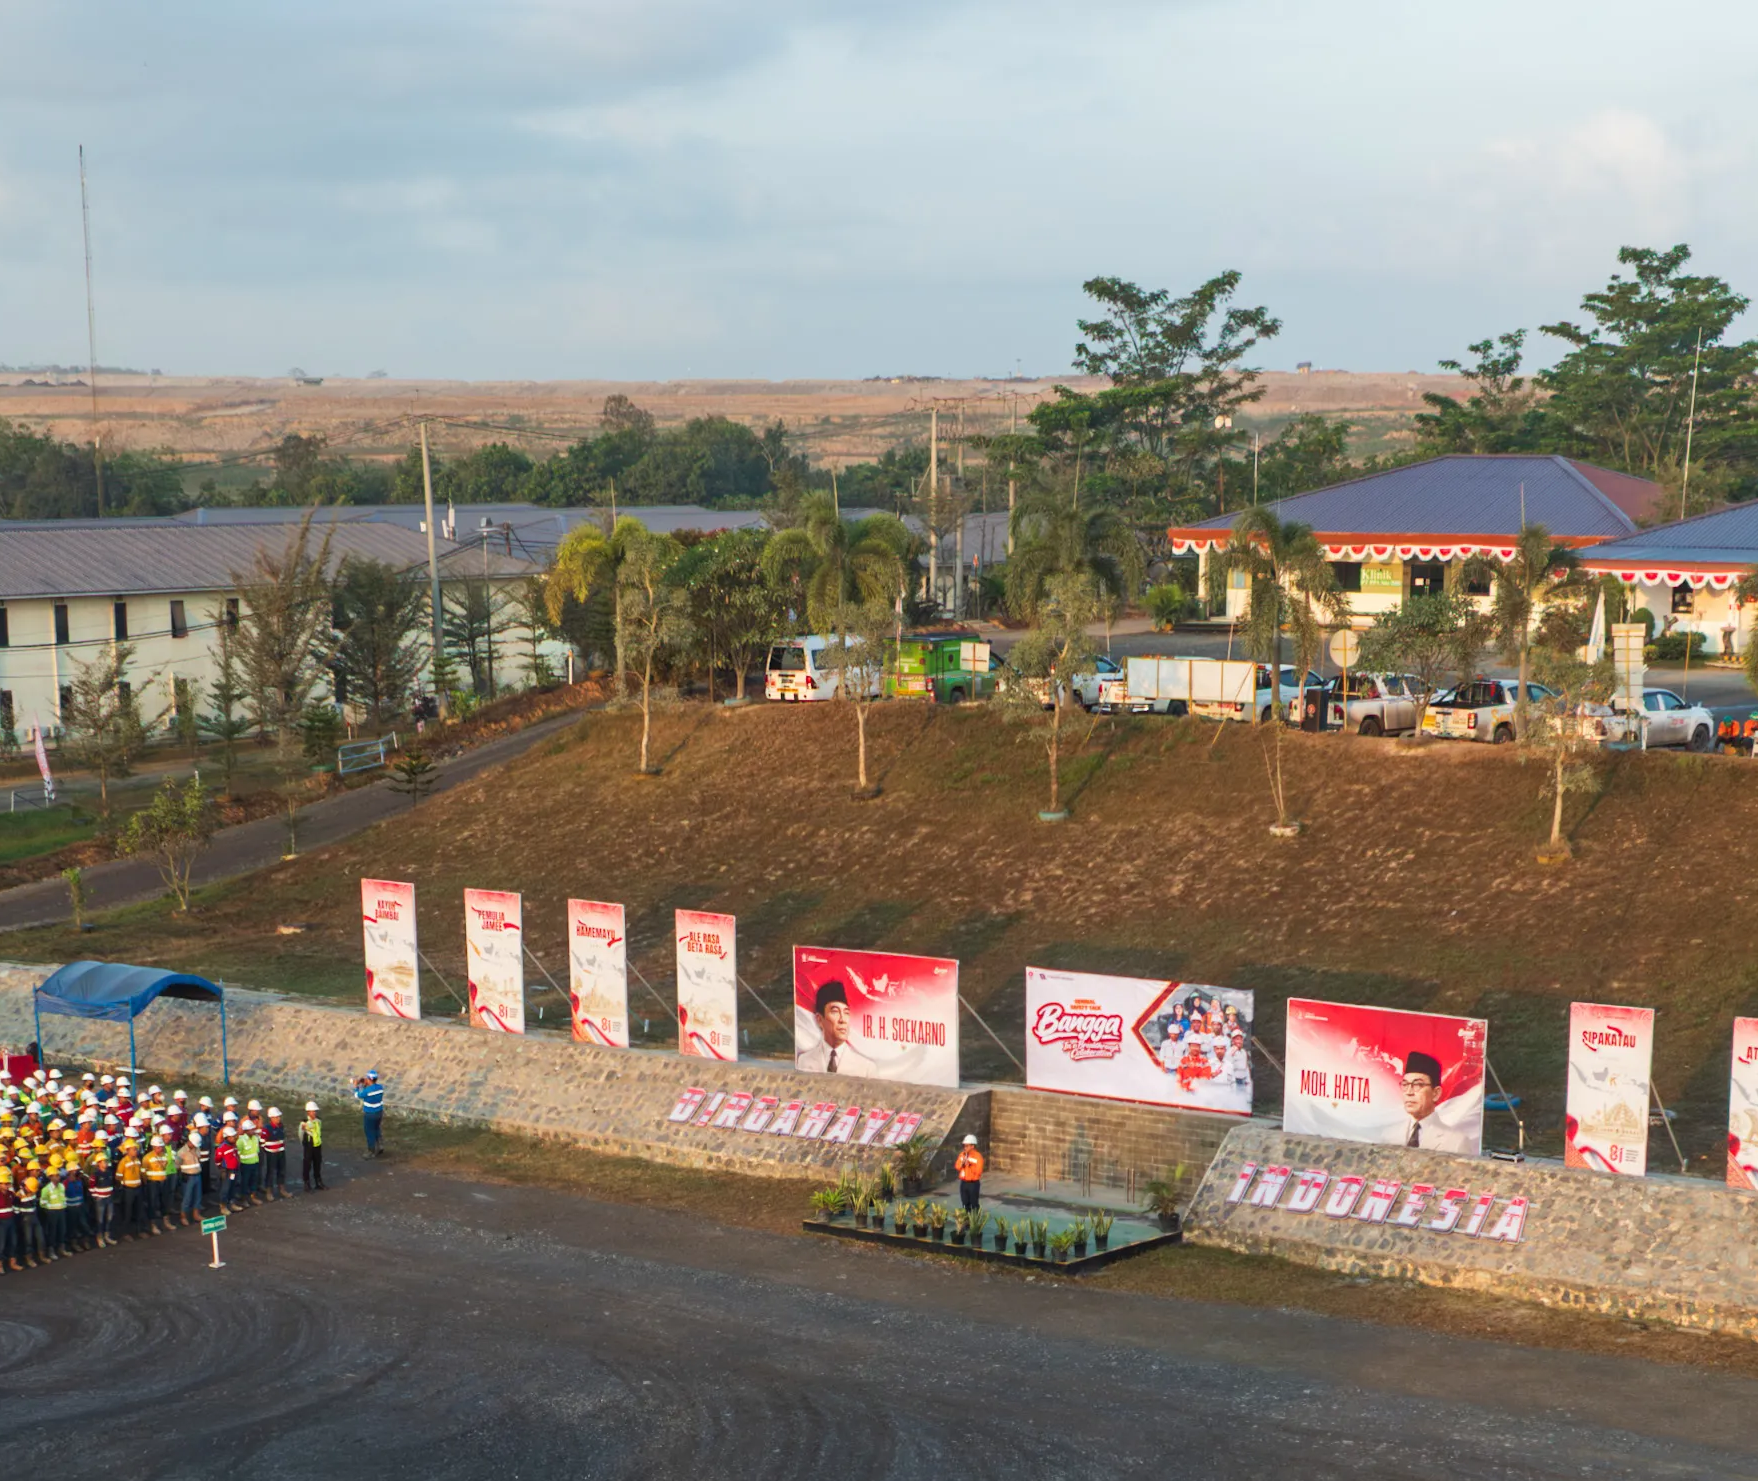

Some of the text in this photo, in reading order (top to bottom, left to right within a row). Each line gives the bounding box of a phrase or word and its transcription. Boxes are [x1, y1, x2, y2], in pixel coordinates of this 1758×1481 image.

[576, 926, 616, 940] HAMEMAYU
[687, 942, 723, 955] BETA RASA
[688, 931, 720, 944] ALE RASA
[862, 1013, 946, 1047] IR. H. SOEKARNO
[1034, 1003, 1122, 1043] Bangga
[1582, 1030, 1637, 1049] SIPAKATAU
[1300, 1069, 1371, 1104] MOH. HATTA
[667, 1087, 924, 1148] DIRGAHAYU
[1226, 1162, 1529, 1244] INDONESIA
